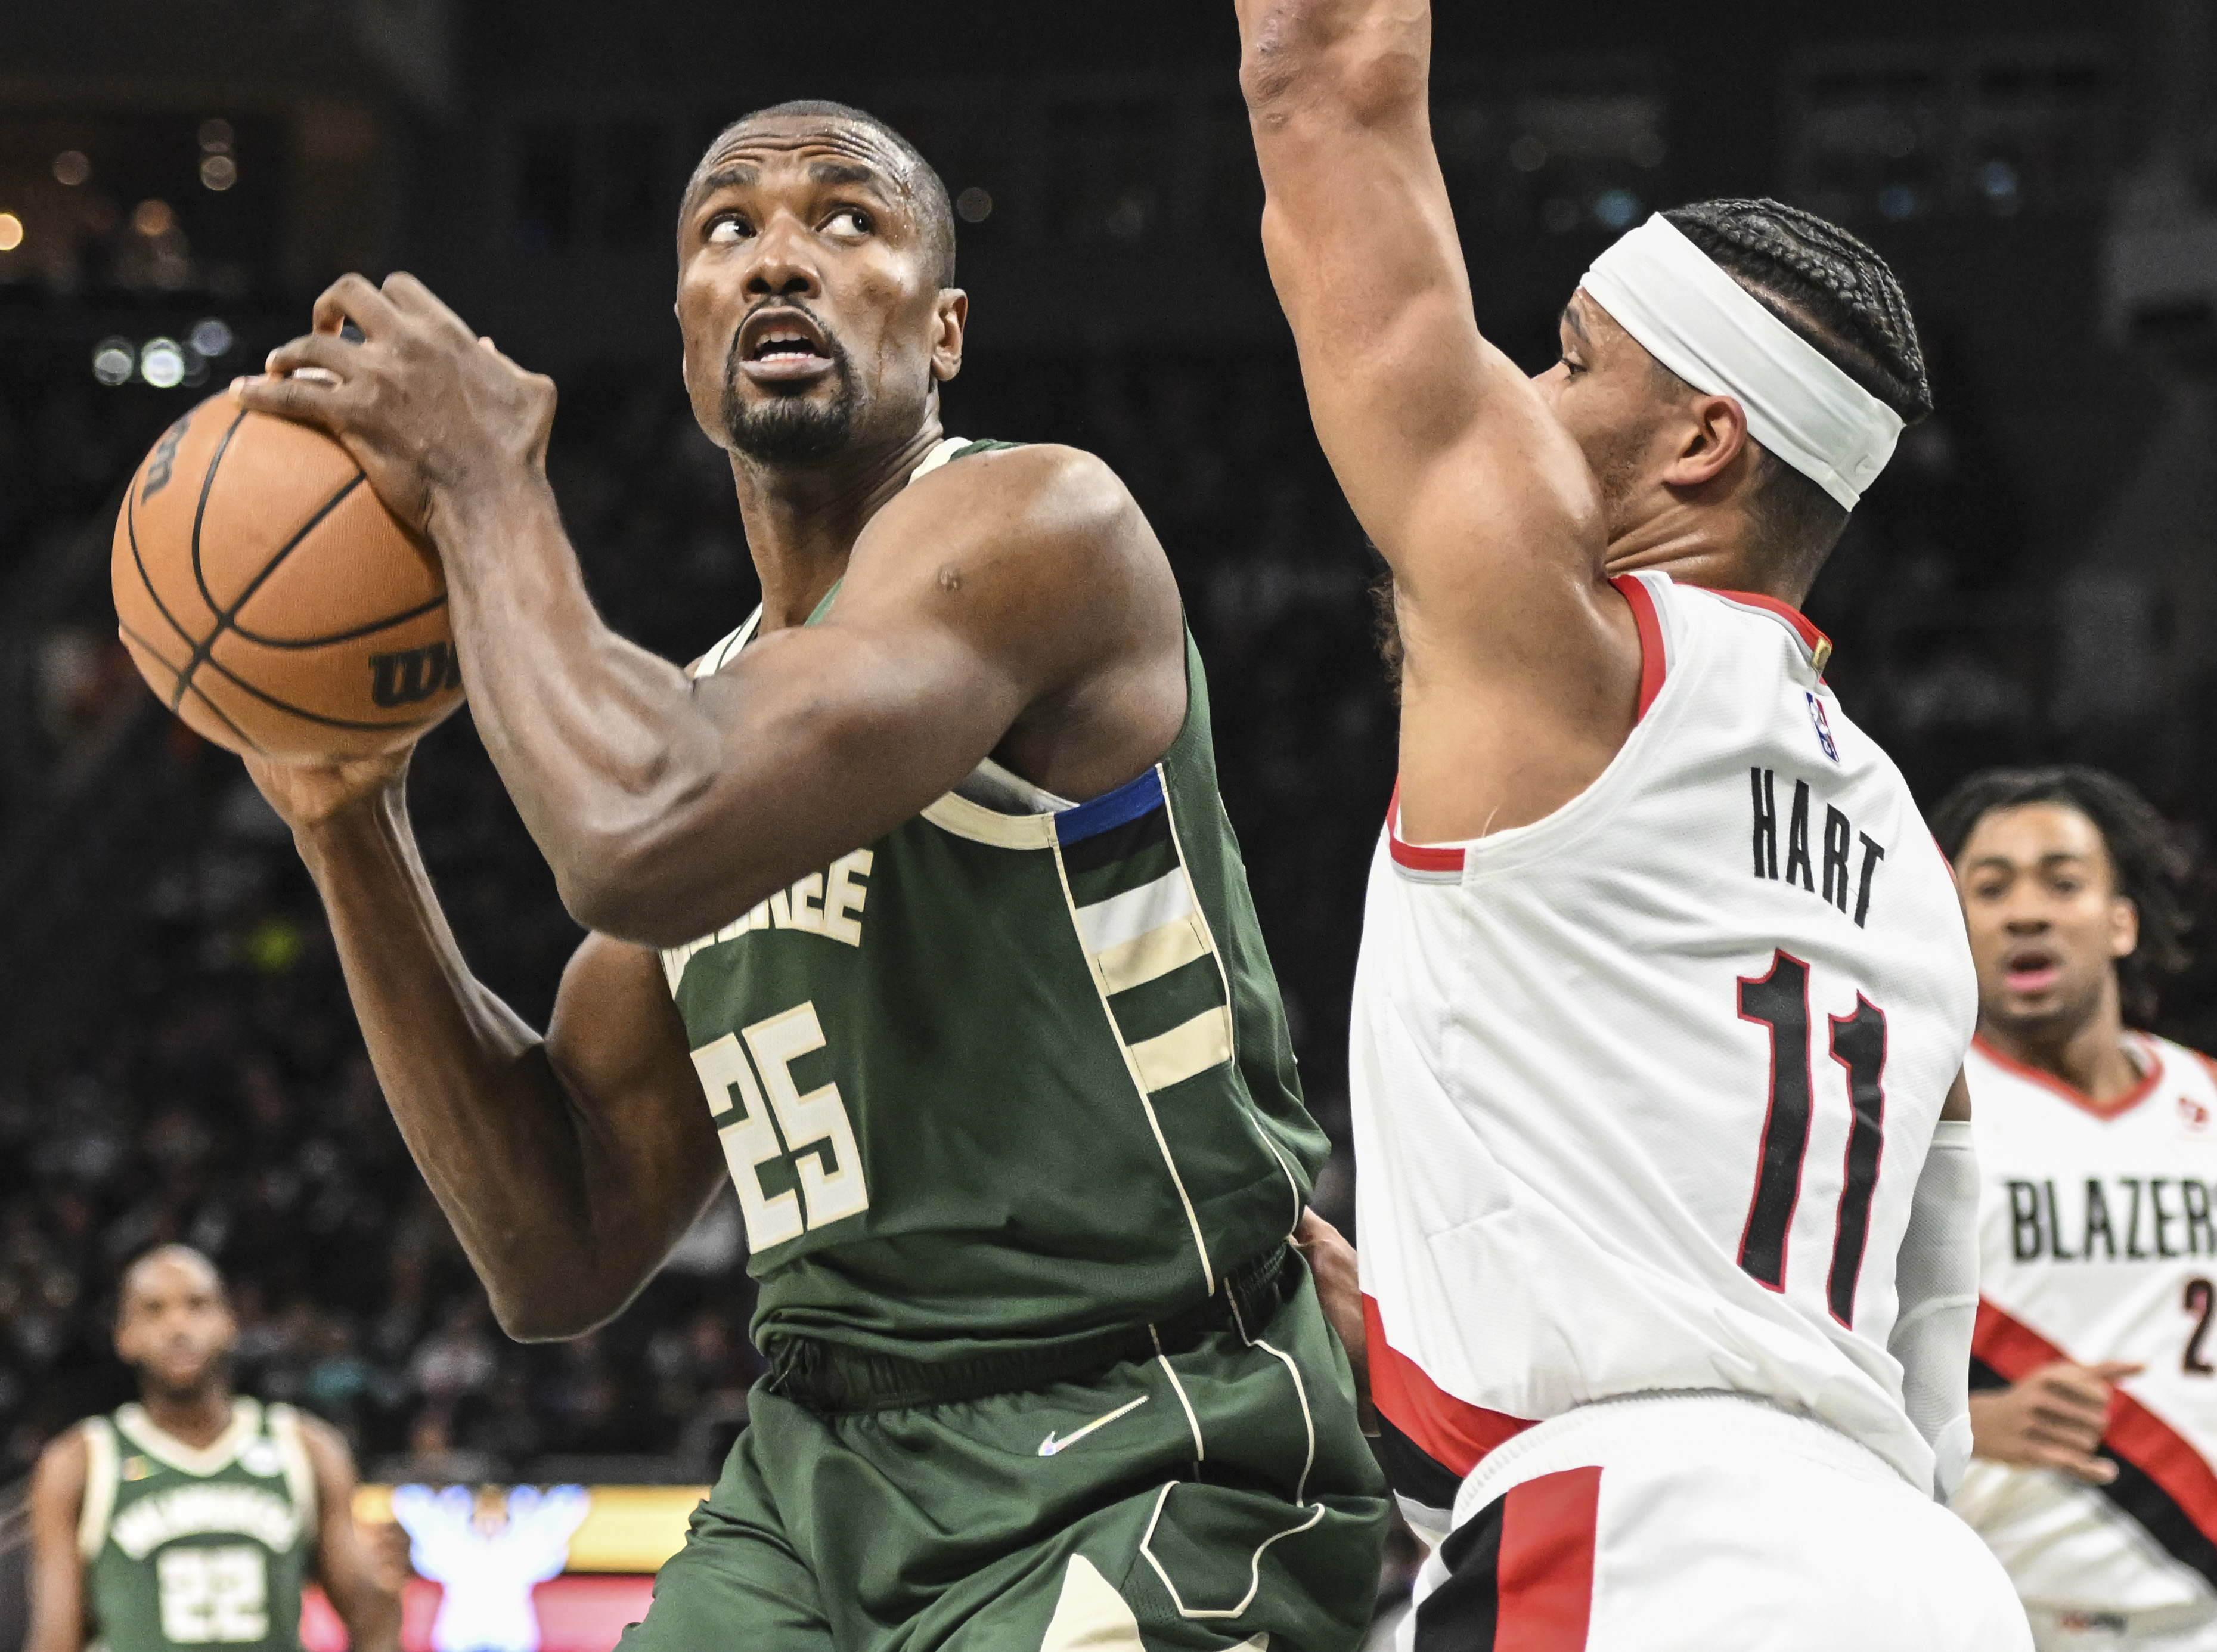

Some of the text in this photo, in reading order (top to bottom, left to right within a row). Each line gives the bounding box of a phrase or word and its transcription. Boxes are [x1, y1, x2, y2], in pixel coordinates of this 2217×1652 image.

[1750, 767, 1885, 929] HART
[690, 1000, 869, 1255] 25
[1736, 947, 1887, 1332] 11
[2005, 1176, 2217, 1261] BLAZER
